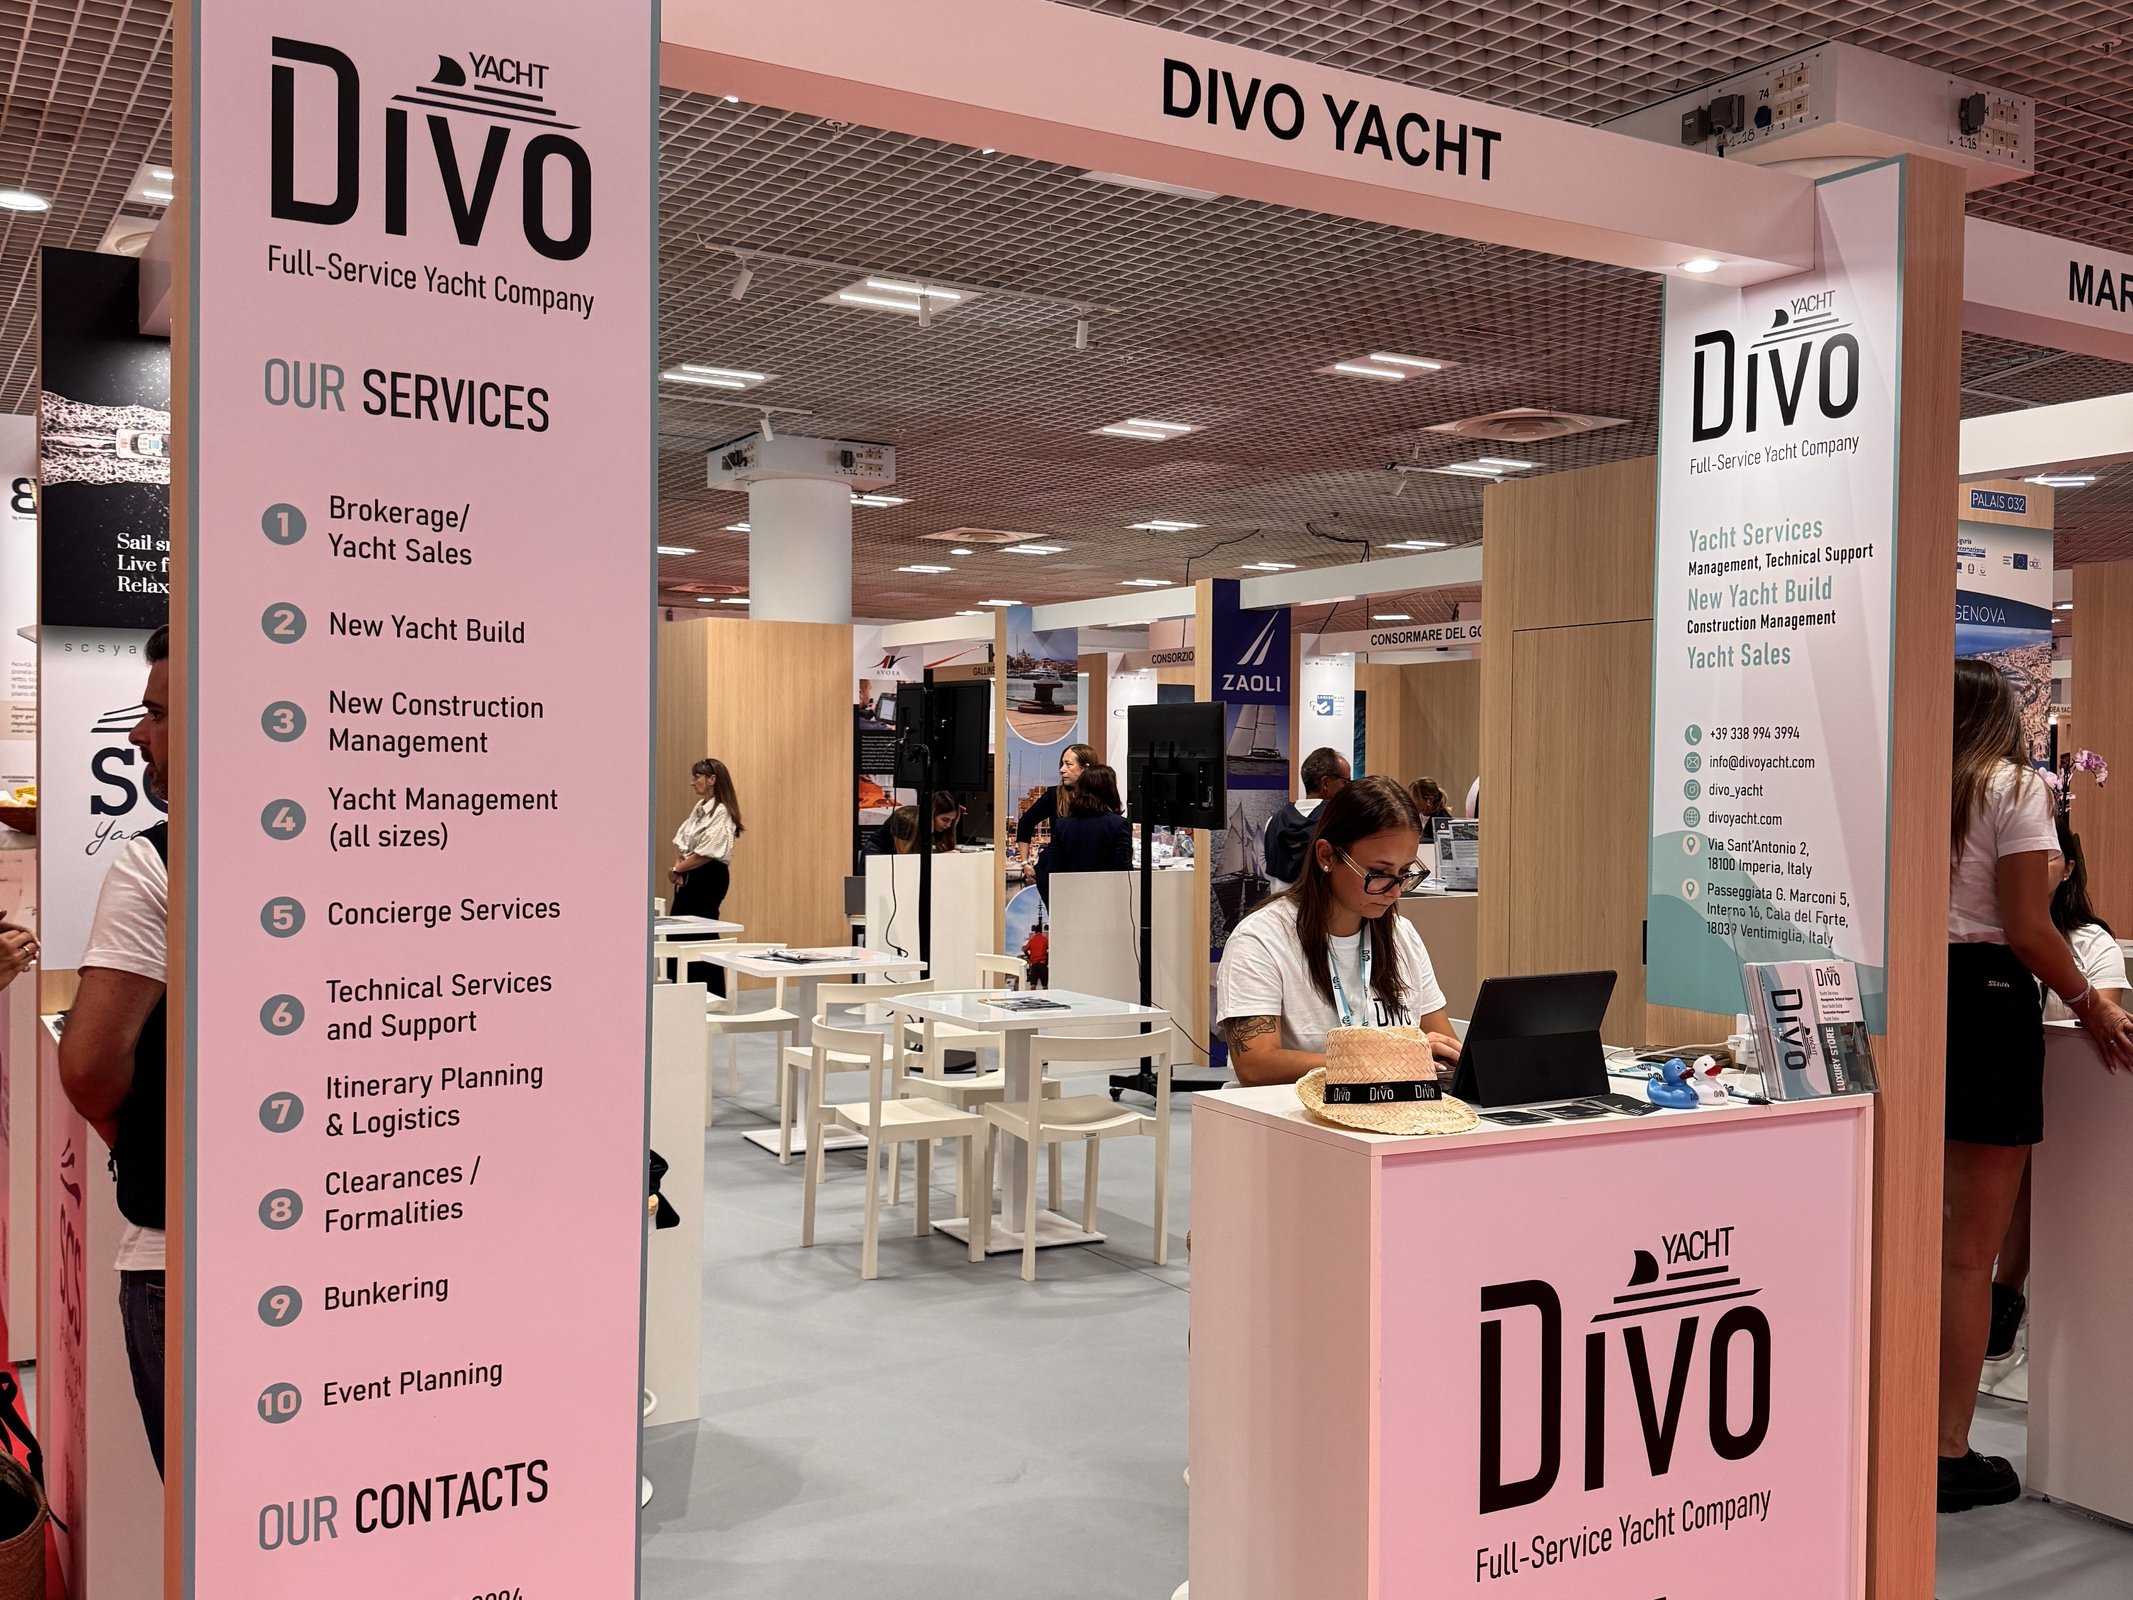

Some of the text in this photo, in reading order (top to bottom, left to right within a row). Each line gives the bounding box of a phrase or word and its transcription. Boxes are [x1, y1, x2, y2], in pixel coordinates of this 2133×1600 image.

[469, 51, 549, 89] YACHT
[1759, 88, 1769, 100] 74
[1163, 58, 1502, 181] DIVO YACHT
[268, 245, 594, 319] Full-Service Yacht Company
[1791, 290, 1836, 315] YACHT
[264, 358, 550, 433] OUR SERVICES
[1690, 436, 1860, 475] Full-Service Yacht Company
[330, 495, 470, 532] Brokerage/
[1973, 493, 2025, 511] PALAIS 032
[277, 512, 289, 537] 1
[1690, 518, 1823, 552] Yacht Services
[117, 532, 152, 551] Sail
[328, 533, 472, 565] Yacht Sales
[117, 554, 157, 572] Live
[1688, 543, 1874, 577] Management, Technical Support
[117, 576, 170, 594] Relax
[1688, 575, 1832, 611] New Yacht Build
[273, 610, 295, 635] 2
[330, 612, 525, 644] New Yacht Build
[1687, 610, 1836, 634] Construction Management
[1371, 628, 1443, 647] CONSORMARE
[1446, 626, 1466, 640] DEL
[1152, 651, 1195, 664] CONSORZIO
[1687, 642, 1791, 669] Yacht Sales
[1222, 674, 1281, 692] ZAOLI
[329, 690, 544, 718] New Construction
[272, 709, 295, 734] 3
[1710, 726, 1800, 740] +39 338 994 3994
[329, 728, 488, 758] Management
[1709, 755, 1815, 771] info@divoyacht.com
[328, 787, 559, 816] Yacht Management
[1709, 783, 1763, 798] divo_yacht
[272, 807, 296, 832] 4
[1708, 812, 1783, 829] divoyacht.com
[330, 822, 449, 852] (all sizes)
[1707, 837, 1810, 857] Via Sant'Antonio 2,
[1707, 857, 1812, 879] 18100 Imperia, Italy
[1707, 883, 1850, 908] Passeggiata G. Marconi 5,
[272, 905, 294, 930] 5
[328, 898, 561, 928] Concierge Services
[1707, 902, 1850, 928] Interno 16, Cala del Forte,
[1707, 921, 1834, 948] 18039 Ventimiglia, Italy
[326, 972, 552, 1004] Technical Services
[271, 1002, 293, 1027] 6
[327, 1011, 477, 1041] and Support
[1825, 1026, 1838, 1056] STORE
[326, 1063, 543, 1099] Itinerary Planning
[1834, 1057, 1846, 1091] LUXURY
[271, 1099, 292, 1125] 7
[325, 1106, 460, 1138] & Logistics
[325, 1155, 481, 1196] Clearances /
[269, 1197, 292, 1222] 8
[325, 1199, 463, 1233] Formalities
[1661, 1226, 1734, 1264] YACHT
[270, 1294, 290, 1319] 9
[325, 1277, 449, 1311] Bunkering
[323, 1362, 503, 1406] Event Planning
[261, 1391, 296, 1417] 10
[258, 1459, 549, 1551] OUR CONTACTS
[1476, 1490, 1771, 1583] Full-Service Yacht Company
